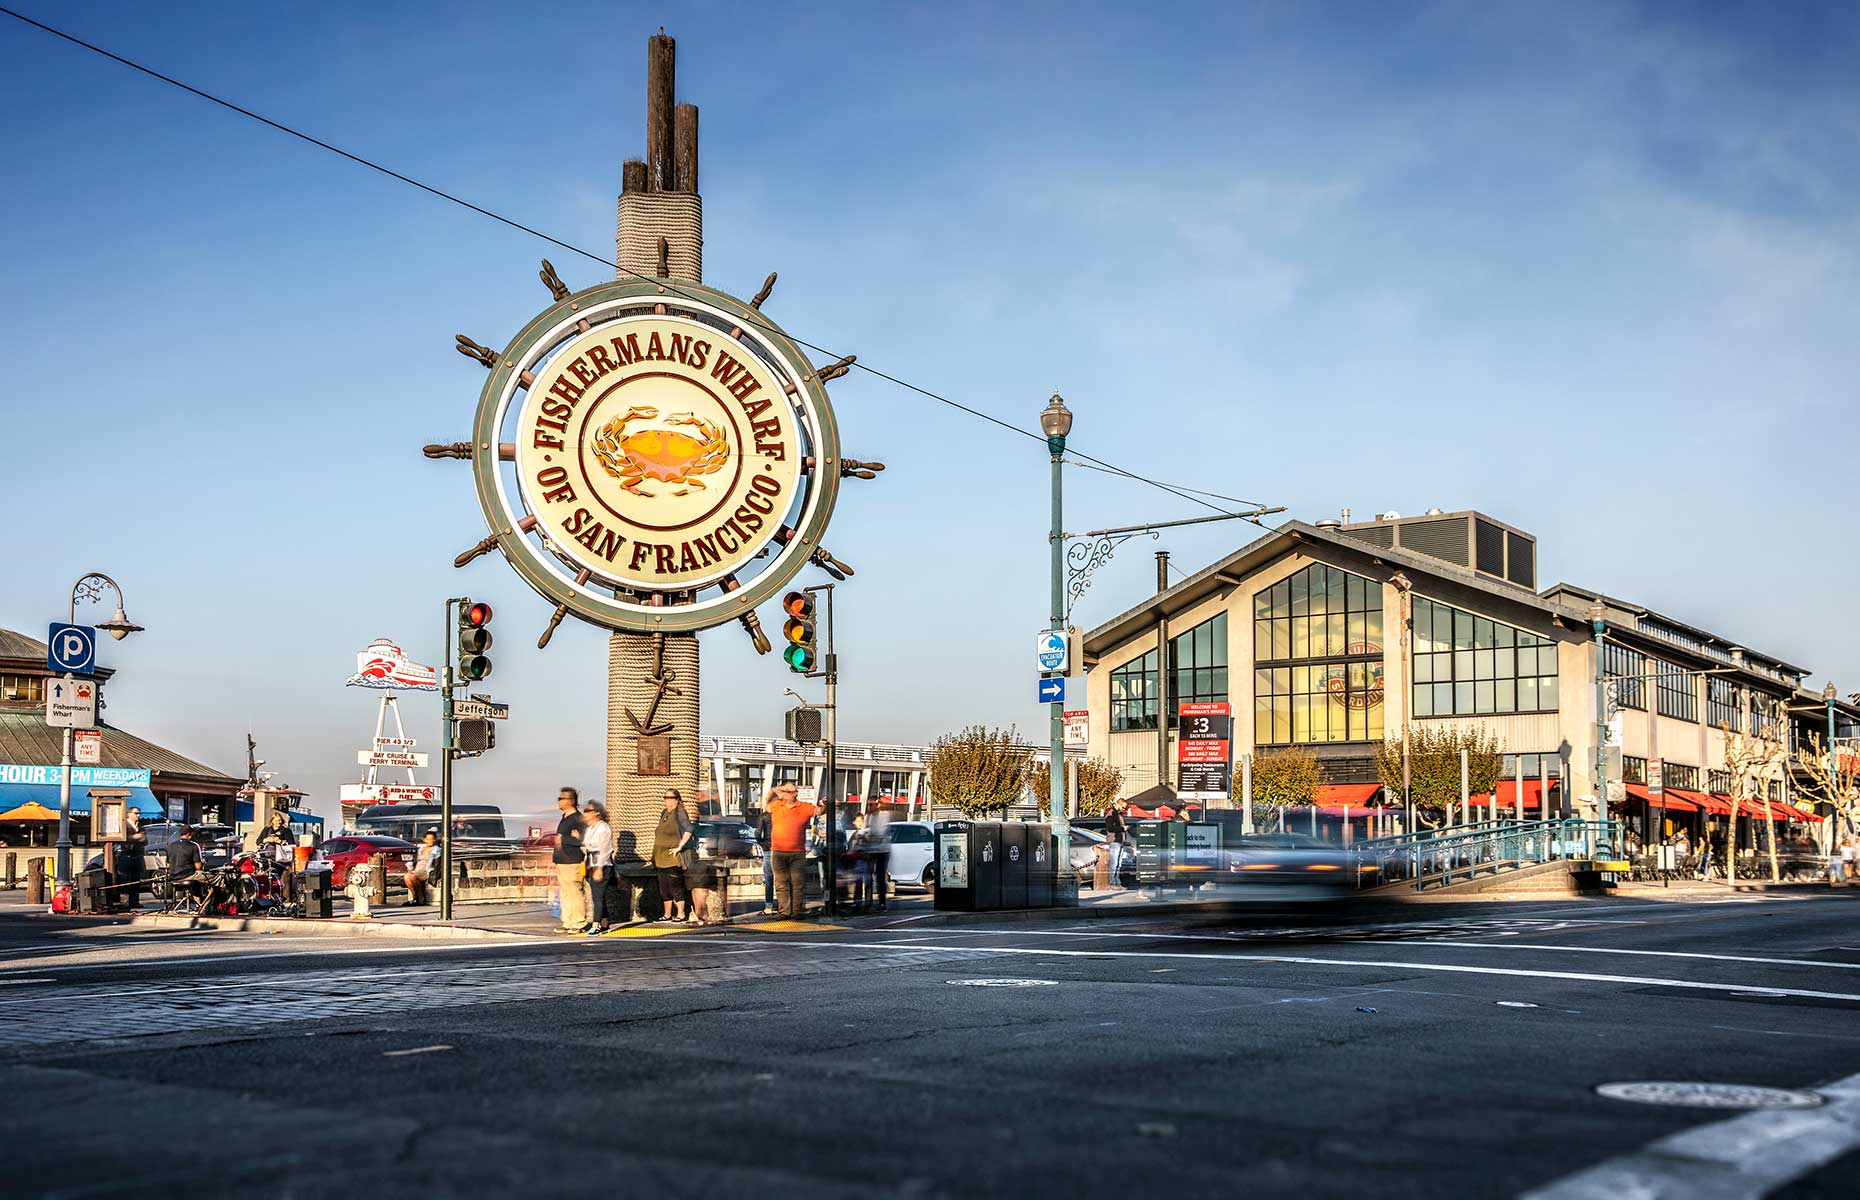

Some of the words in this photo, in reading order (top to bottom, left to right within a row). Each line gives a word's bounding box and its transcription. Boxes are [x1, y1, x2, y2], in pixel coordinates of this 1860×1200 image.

[534, 331, 711, 451] FISHERMANS
[711, 349, 786, 463] WHARF
[536, 466, 577, 504] OF
[561, 507, 628, 563] SAN
[628, 473, 782, 575] FRANCISCO
[63, 635, 84, 661] P
[53, 703, 91, 712] Fisherman's
[458, 703, 504, 716] Jefferson
[93, 770, 148, 781] WEEKDAYS
